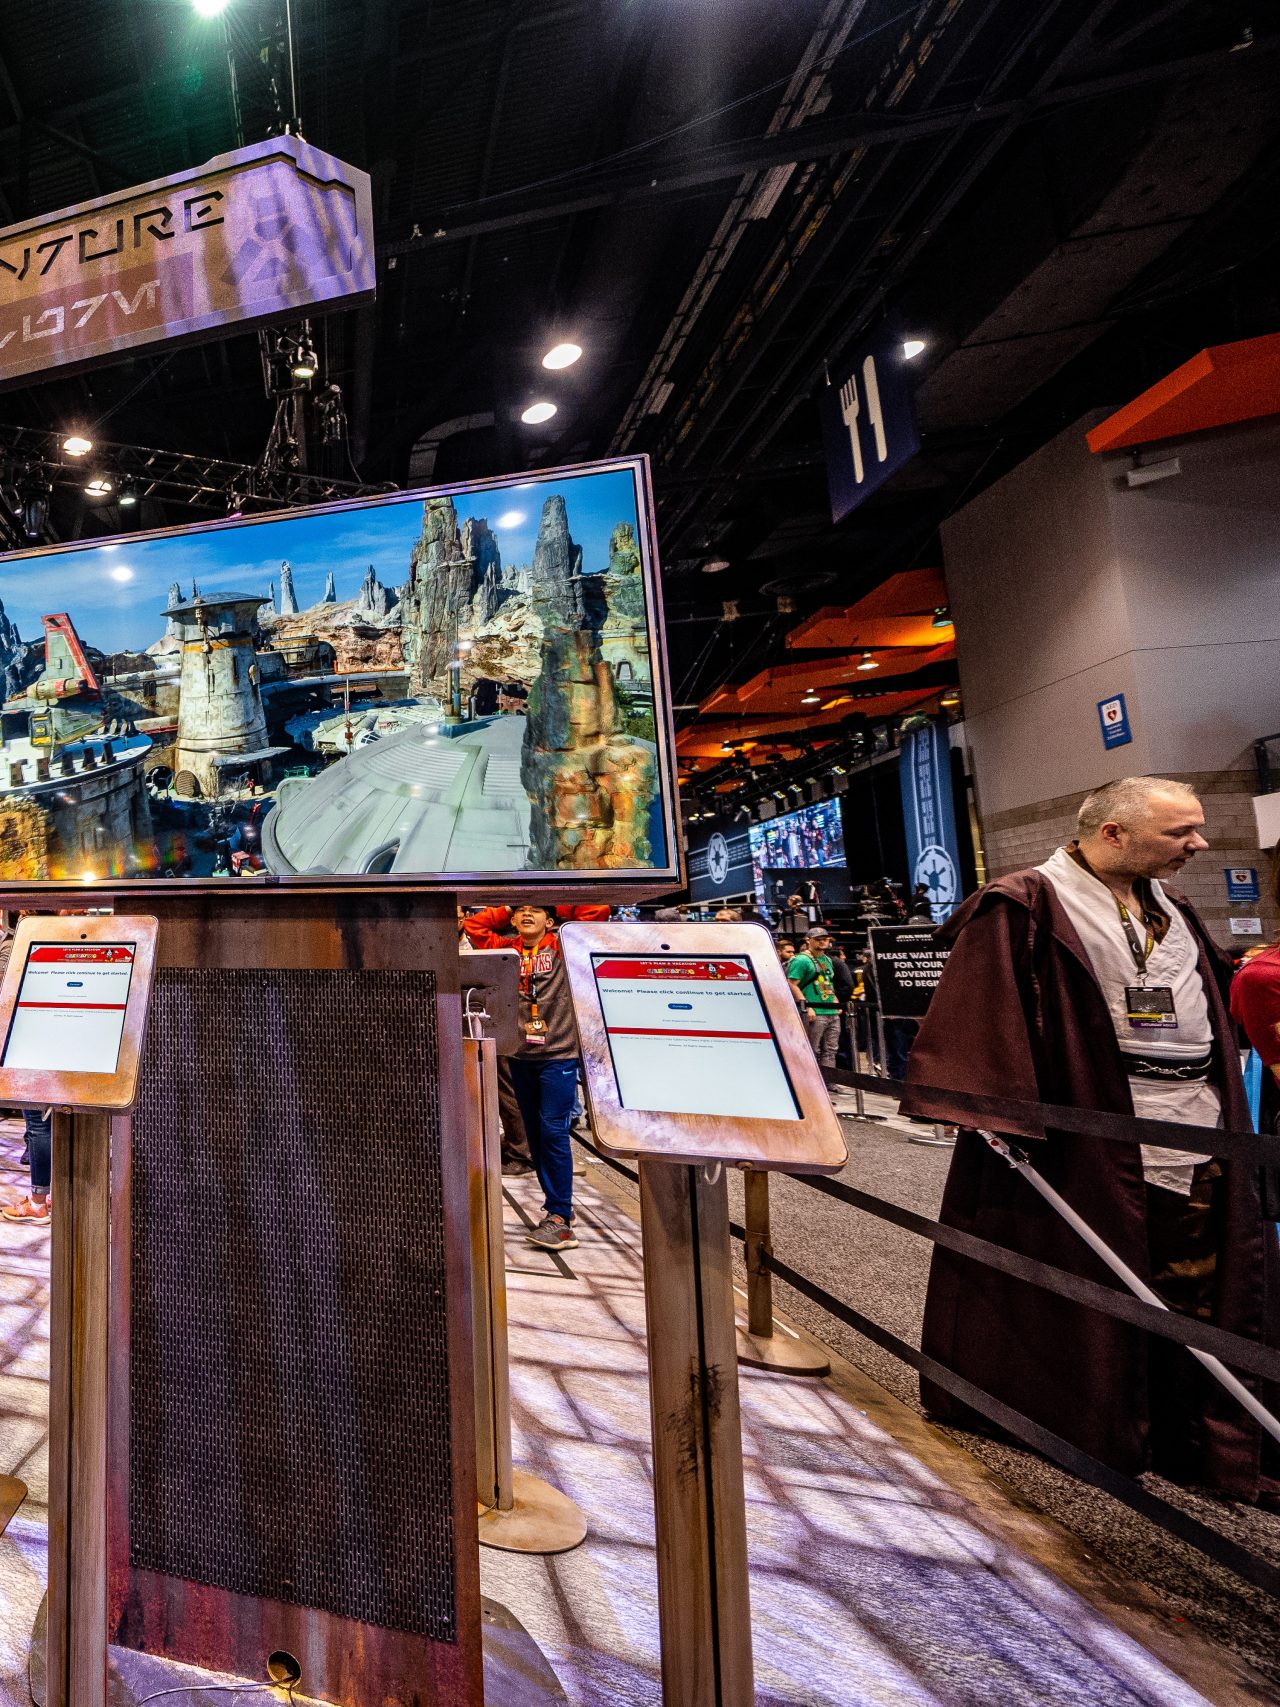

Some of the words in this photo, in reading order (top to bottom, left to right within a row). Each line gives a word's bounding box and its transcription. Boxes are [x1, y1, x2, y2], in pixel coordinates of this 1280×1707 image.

[876, 952, 908, 960] PLEASE
[909, 951, 933, 959] WAIT
[894, 961, 914, 969] FOR
[915, 961, 944, 969] YOUR
[894, 970, 943, 978] ADVENTUR
